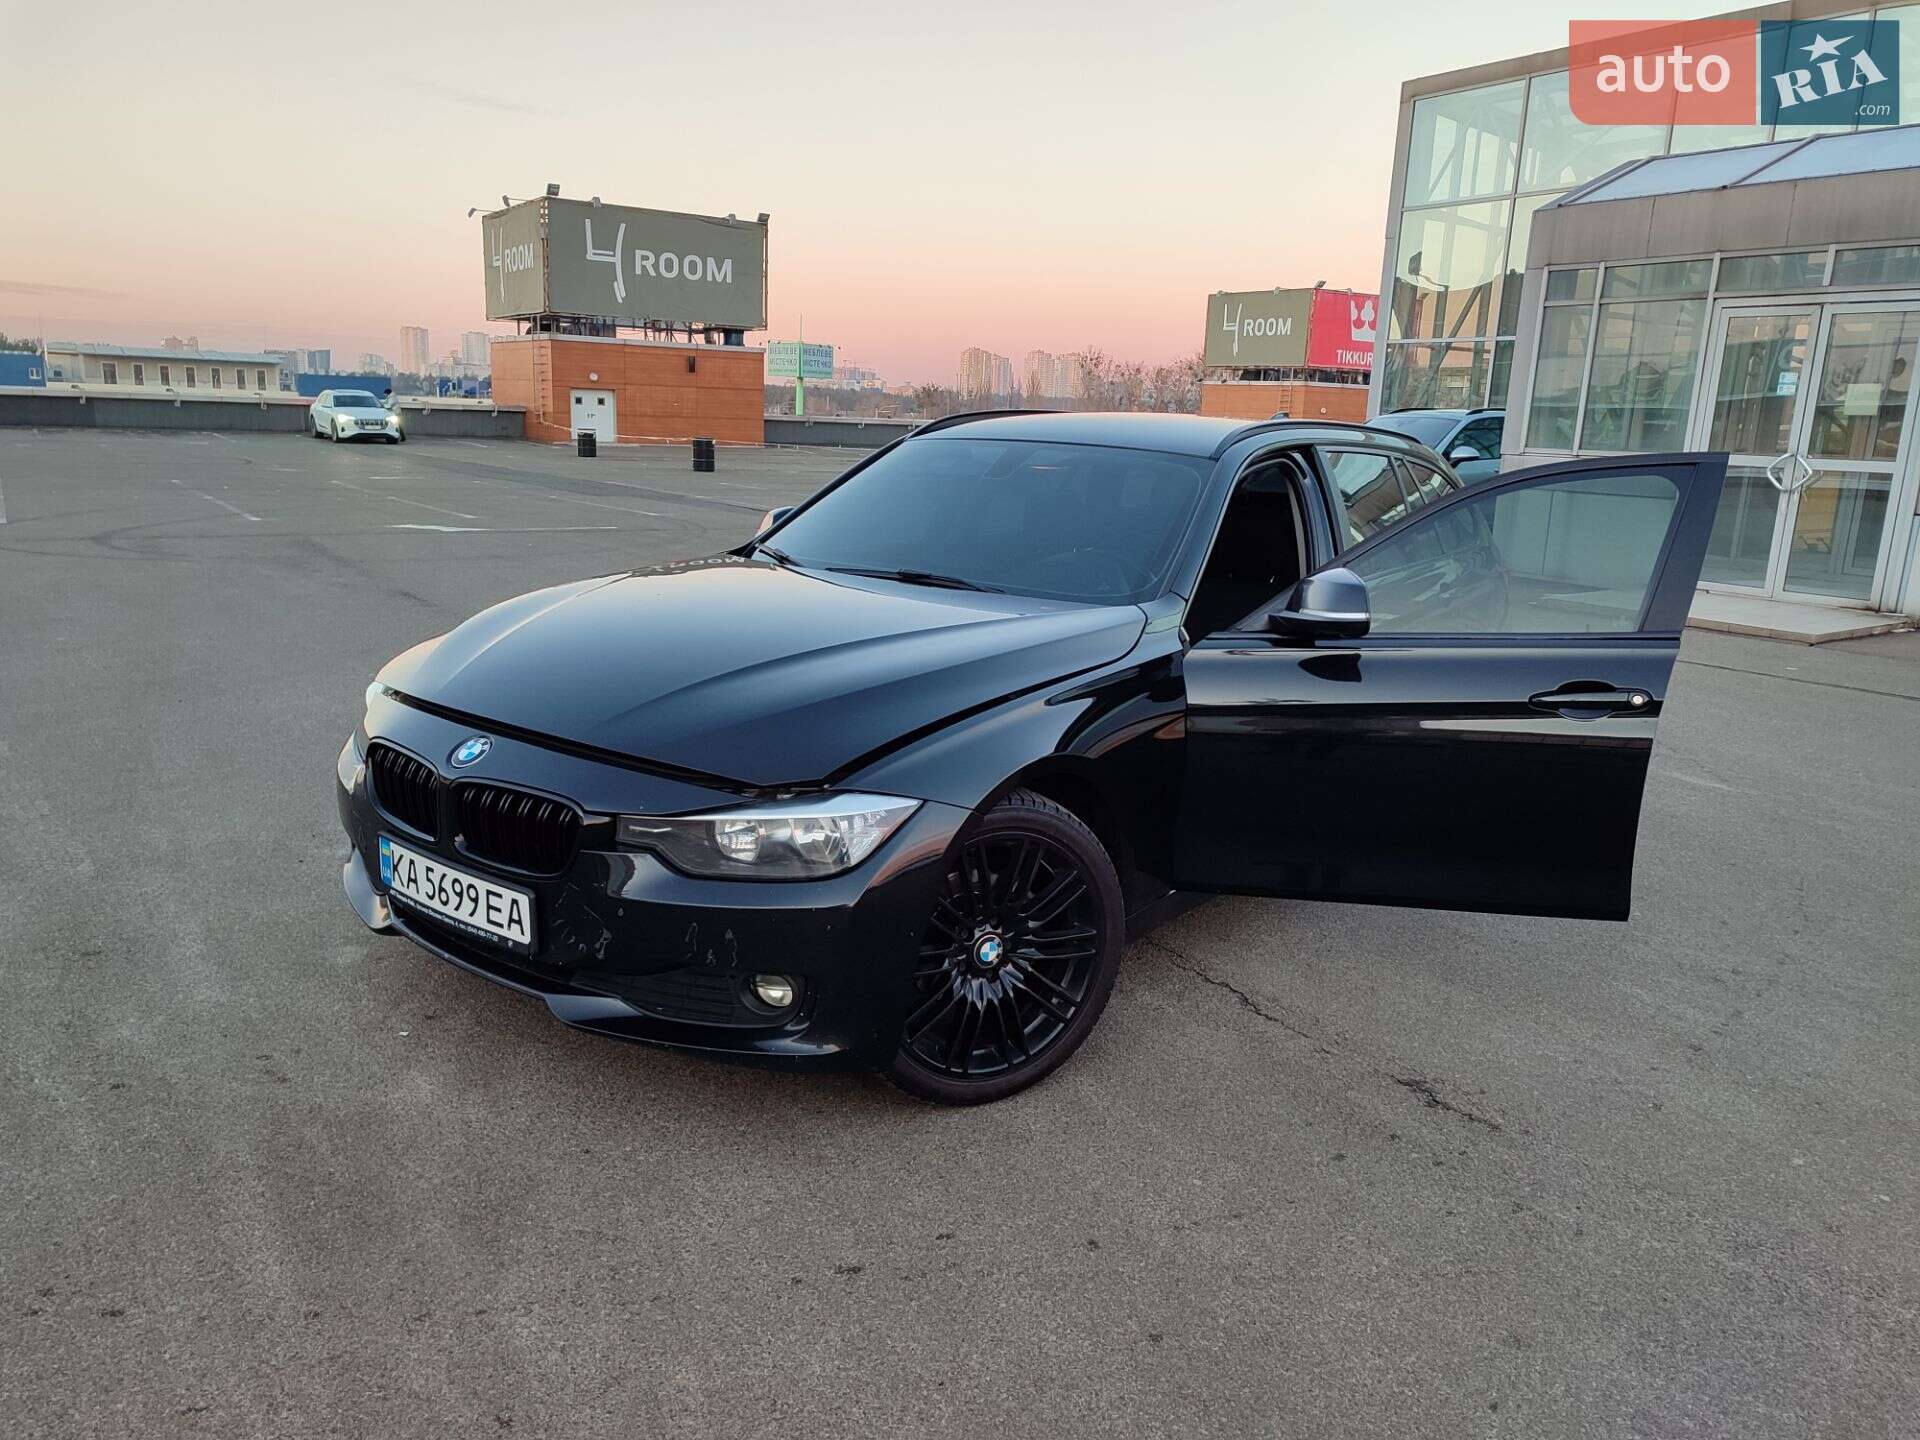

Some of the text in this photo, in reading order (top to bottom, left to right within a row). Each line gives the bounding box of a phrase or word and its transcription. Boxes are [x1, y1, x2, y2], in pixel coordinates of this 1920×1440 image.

[504, 242, 534, 273] ROOM
[634, 249, 733, 284] ROOM
[1243, 317, 1292, 337] ROOM
[391, 850, 420, 895] KA
[425, 865, 479, 918] 5699
[485, 888, 525, 936] EA
